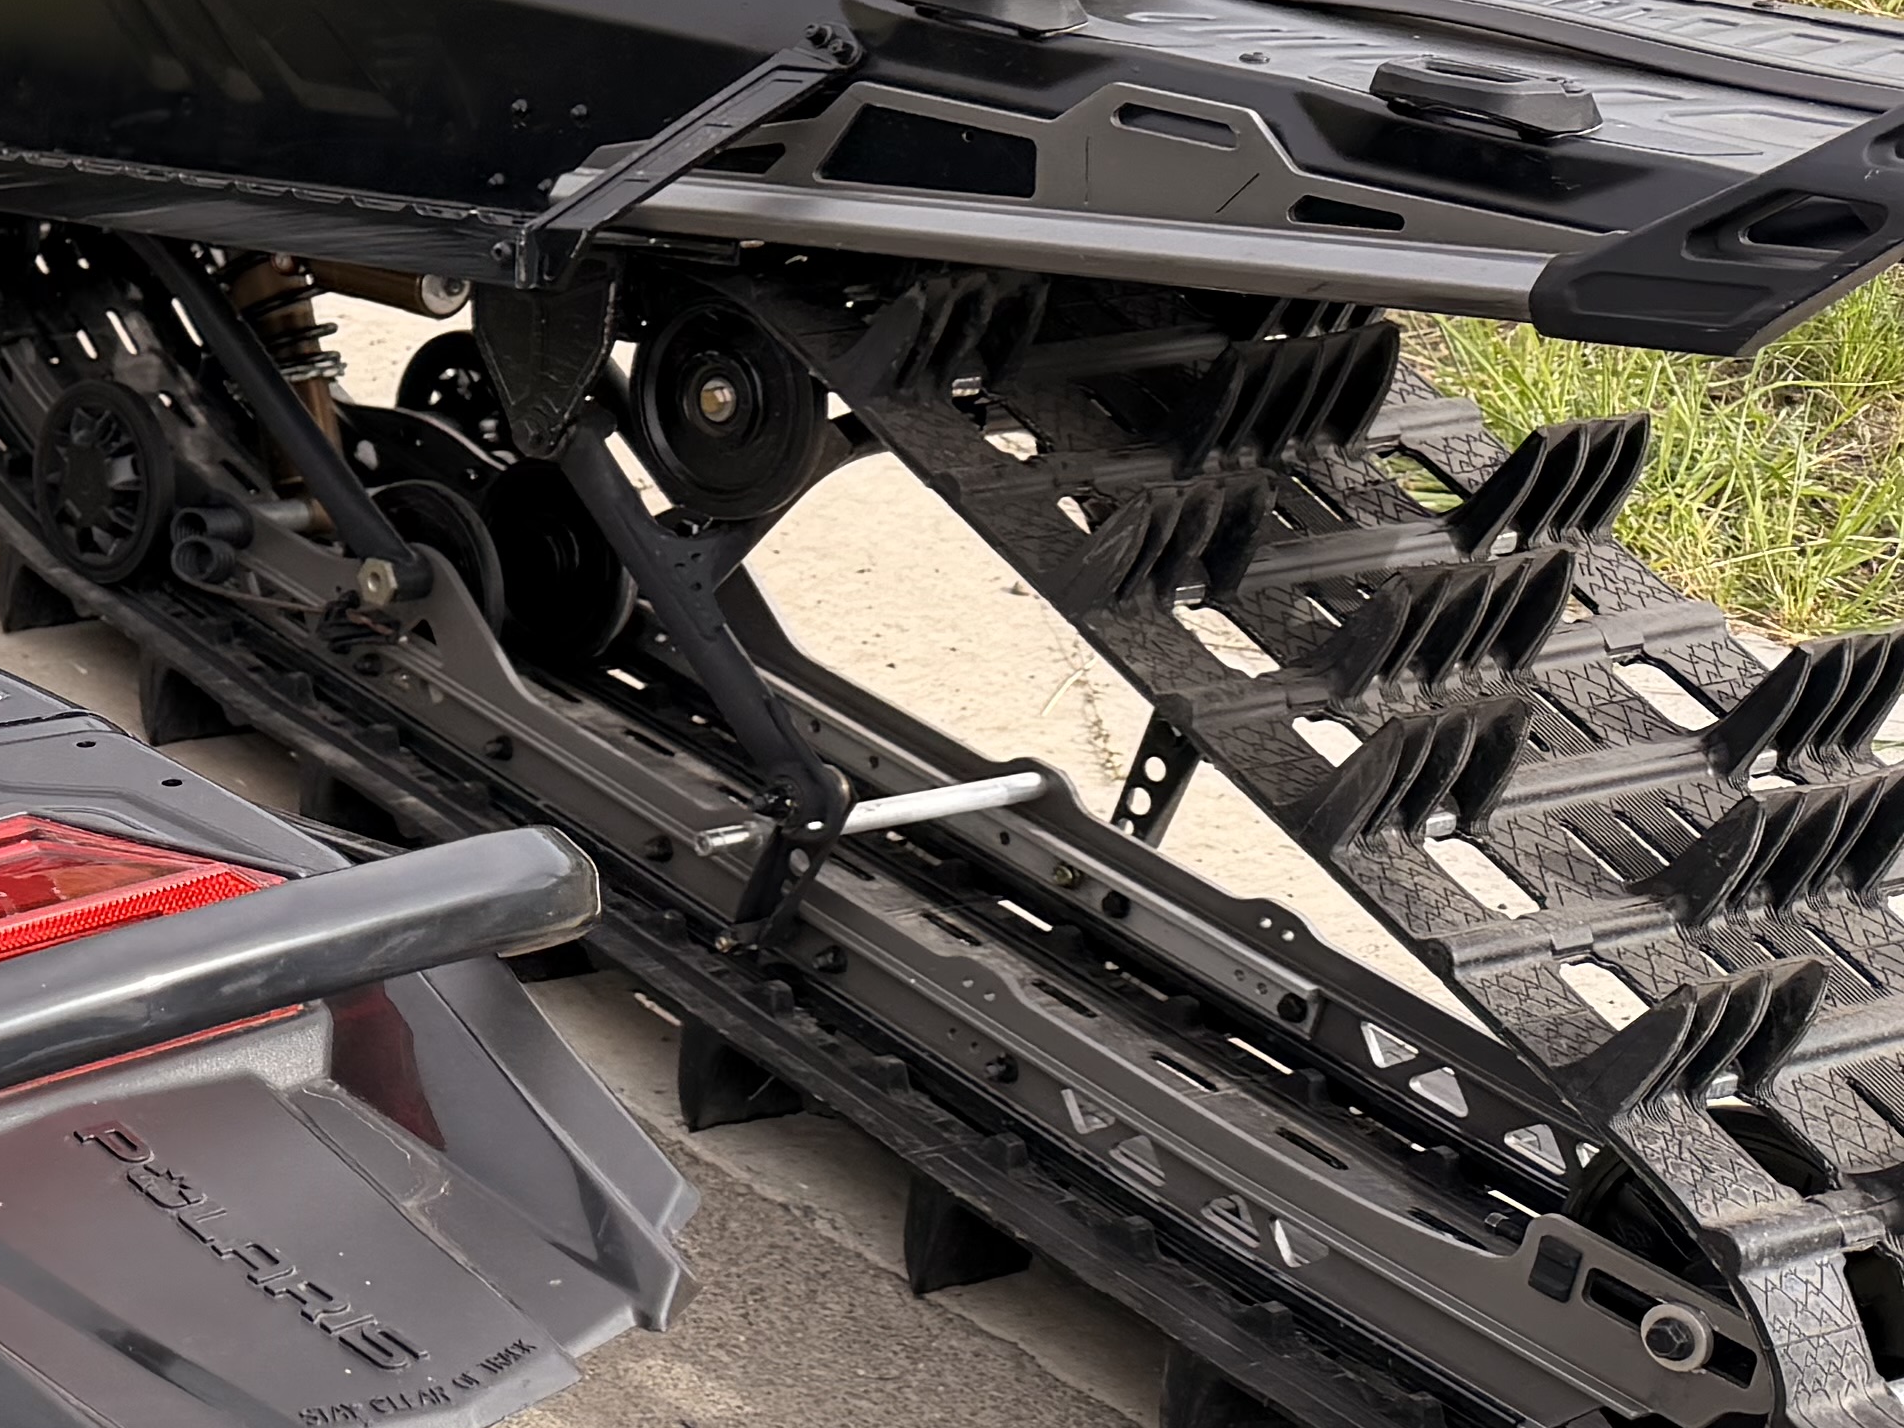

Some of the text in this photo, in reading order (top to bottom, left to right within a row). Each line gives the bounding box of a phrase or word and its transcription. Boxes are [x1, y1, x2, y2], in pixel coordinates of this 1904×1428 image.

[73, 1120, 431, 1372] POLARIS
[299, 1402, 360, 1428] STAY
[370, 1385, 450, 1416] CLEAR
